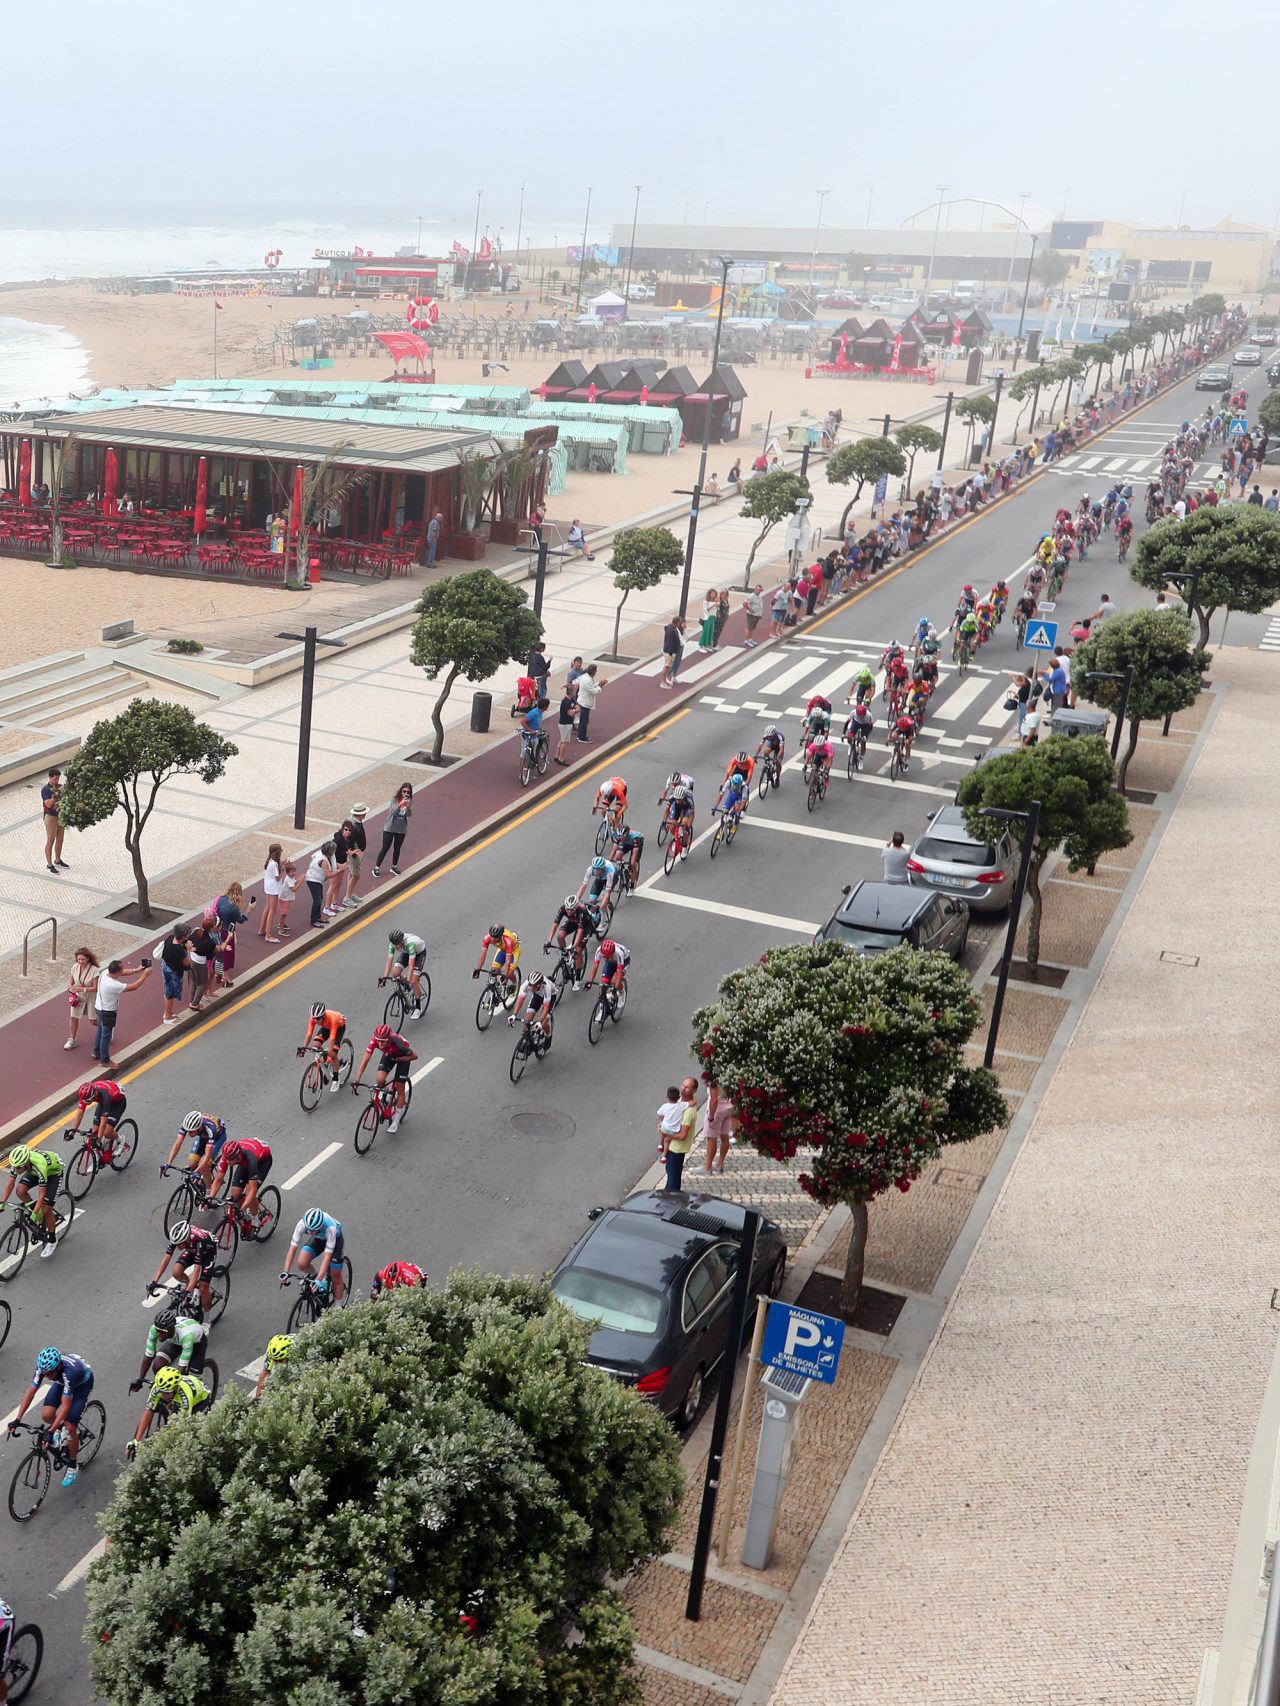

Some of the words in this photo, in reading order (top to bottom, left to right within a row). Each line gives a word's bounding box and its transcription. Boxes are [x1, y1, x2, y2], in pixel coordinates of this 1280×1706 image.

[789, 1309, 825, 1326] MÁQUINA
[784, 1316, 821, 1356] P
[772, 1357, 783, 1366] DE
[785, 1362, 824, 1378] BILHETES
[778, 1352, 819, 1370] EMISSORA
